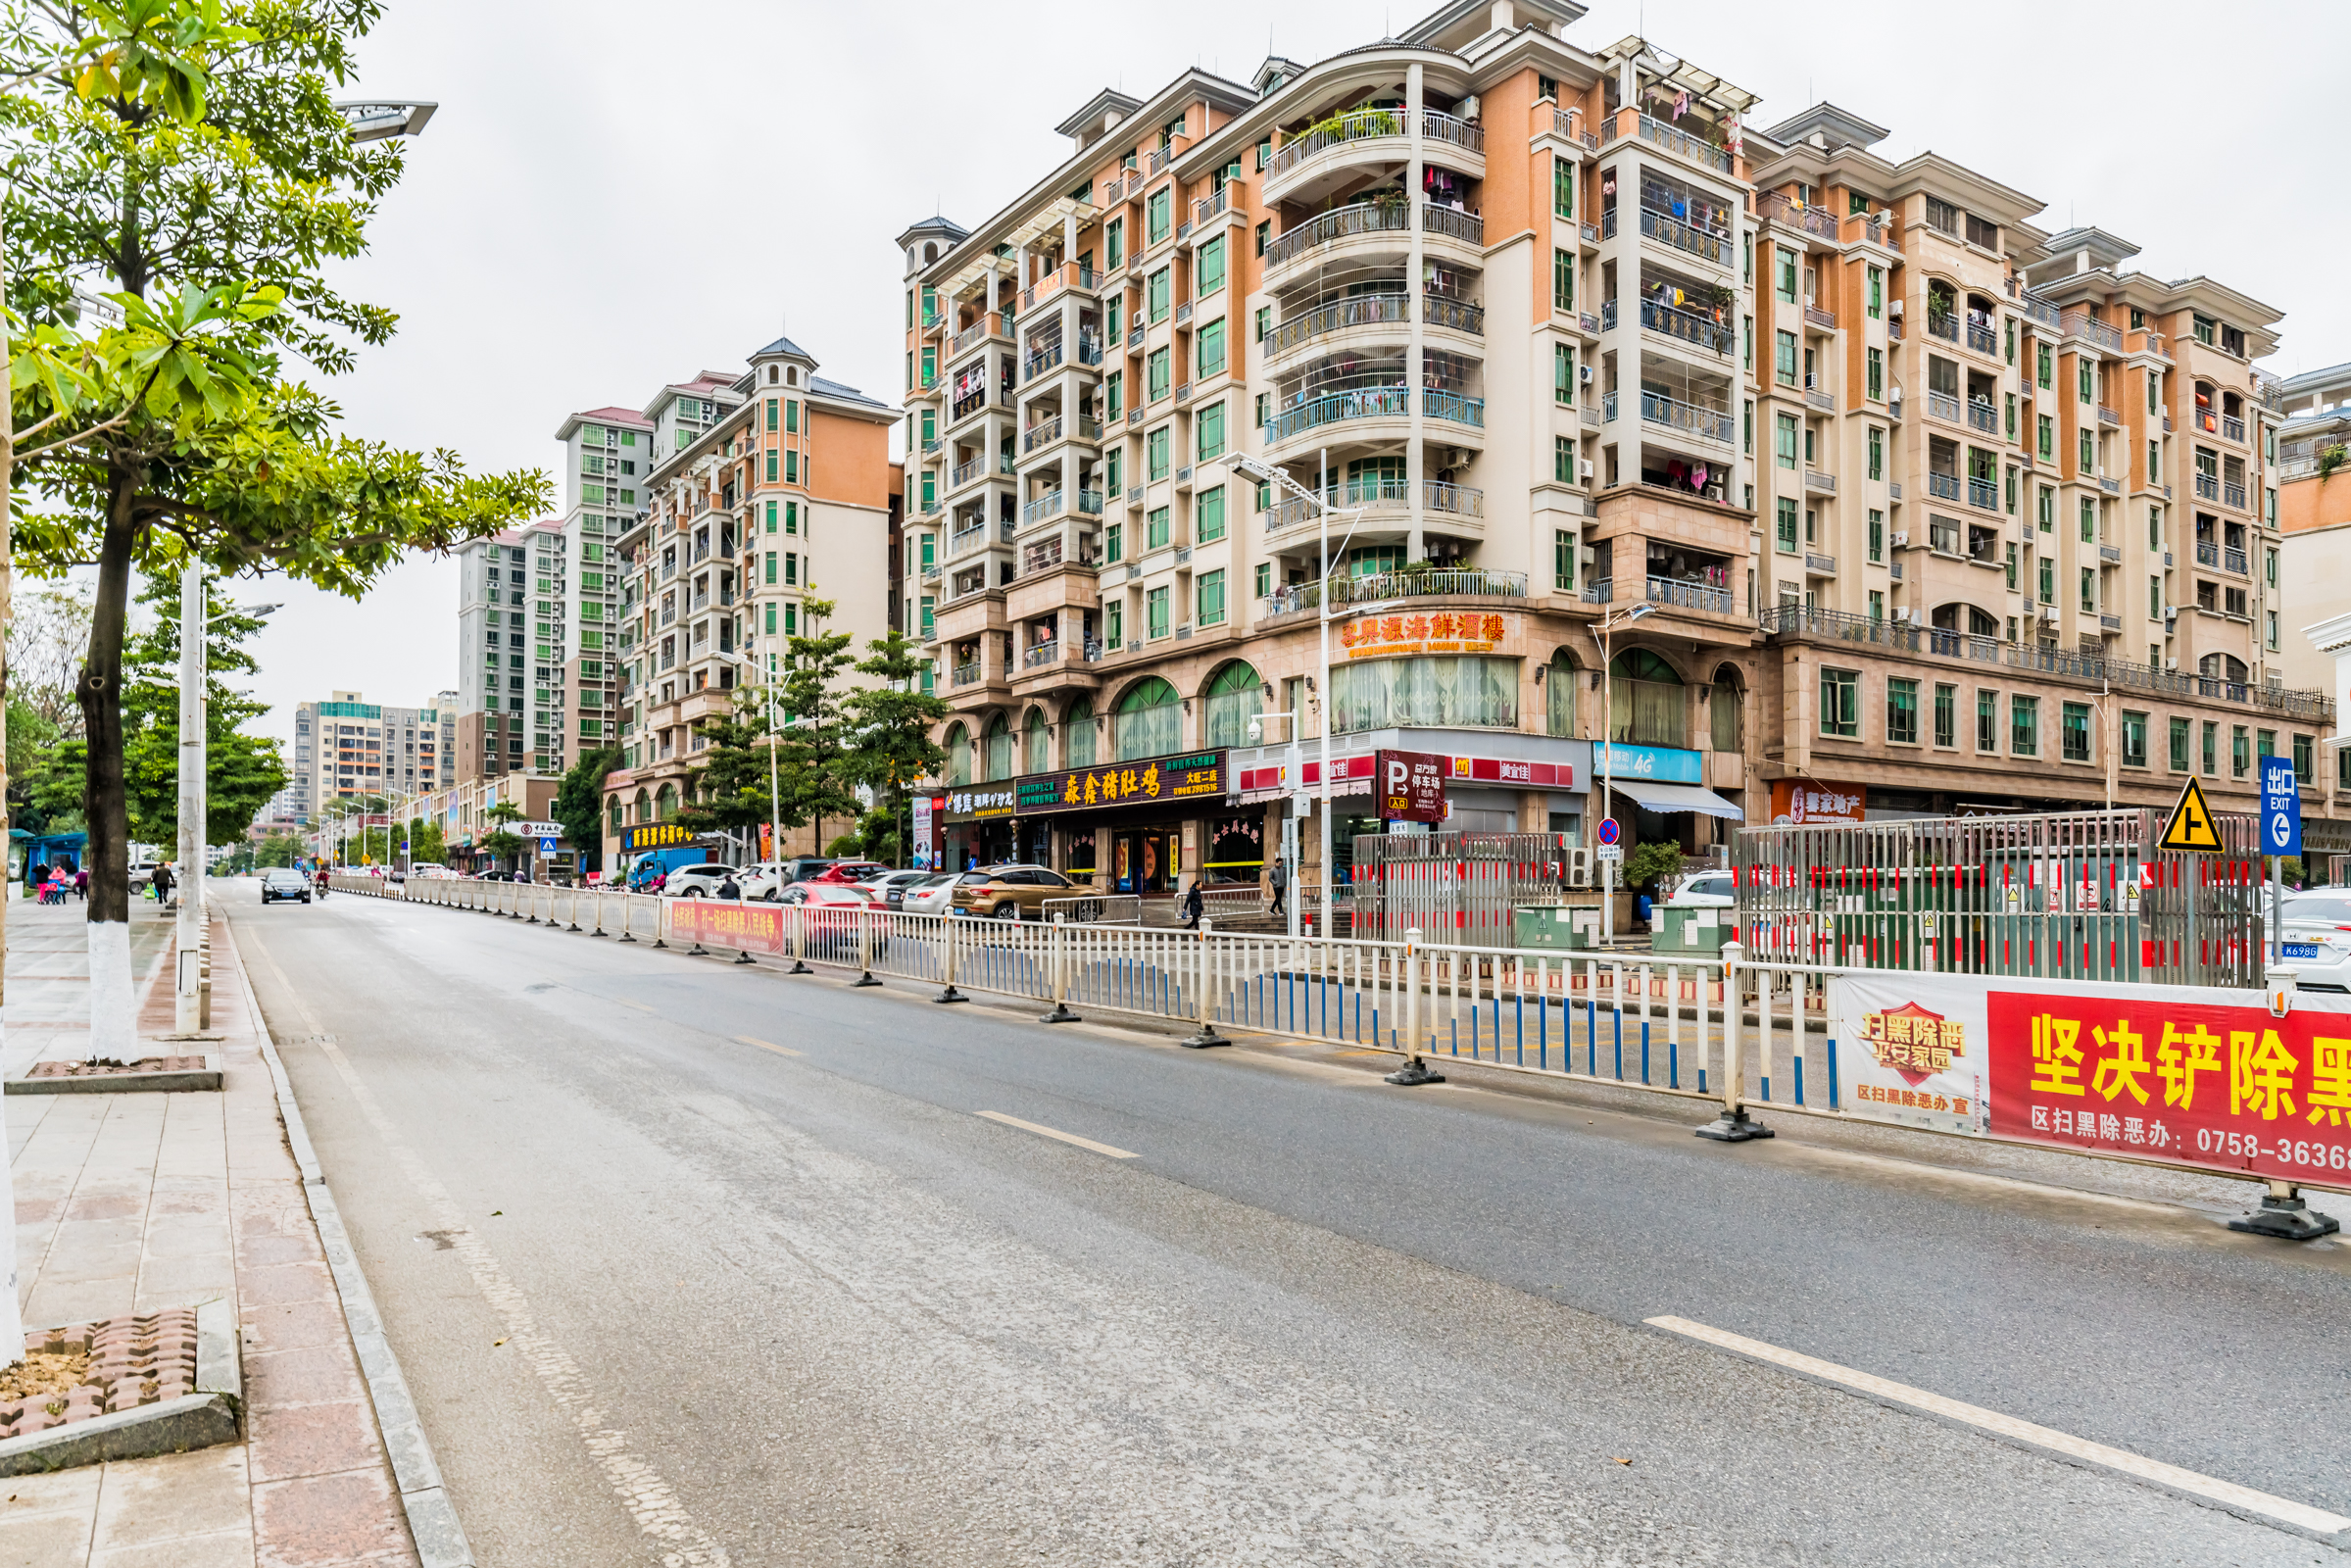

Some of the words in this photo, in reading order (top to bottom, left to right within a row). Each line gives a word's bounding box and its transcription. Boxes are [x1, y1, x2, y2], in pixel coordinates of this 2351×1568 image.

[1501, 762, 1529, 780] 美宜佳
[1634, 754, 1652, 774] 4G
[1186, 769, 1217, 784] 大旺二店
[1388, 760, 1408, 795] P
[1412, 774, 1441, 790] 停车场
[2267, 766, 2295, 796] 出口
[1392, 799, 1405, 808] 入口
[2271, 797, 2290, 810] EXIT
[1857, 1012, 1966, 1055] 扫黑除恶
[1872, 1041, 1952, 1070] 平安家园
[2030, 1011, 2351, 1127] 坚决铲除黑
[1857, 1084, 1949, 1111] 区扫黑除恶办
[1952, 1098, 1969, 1116] 宣
